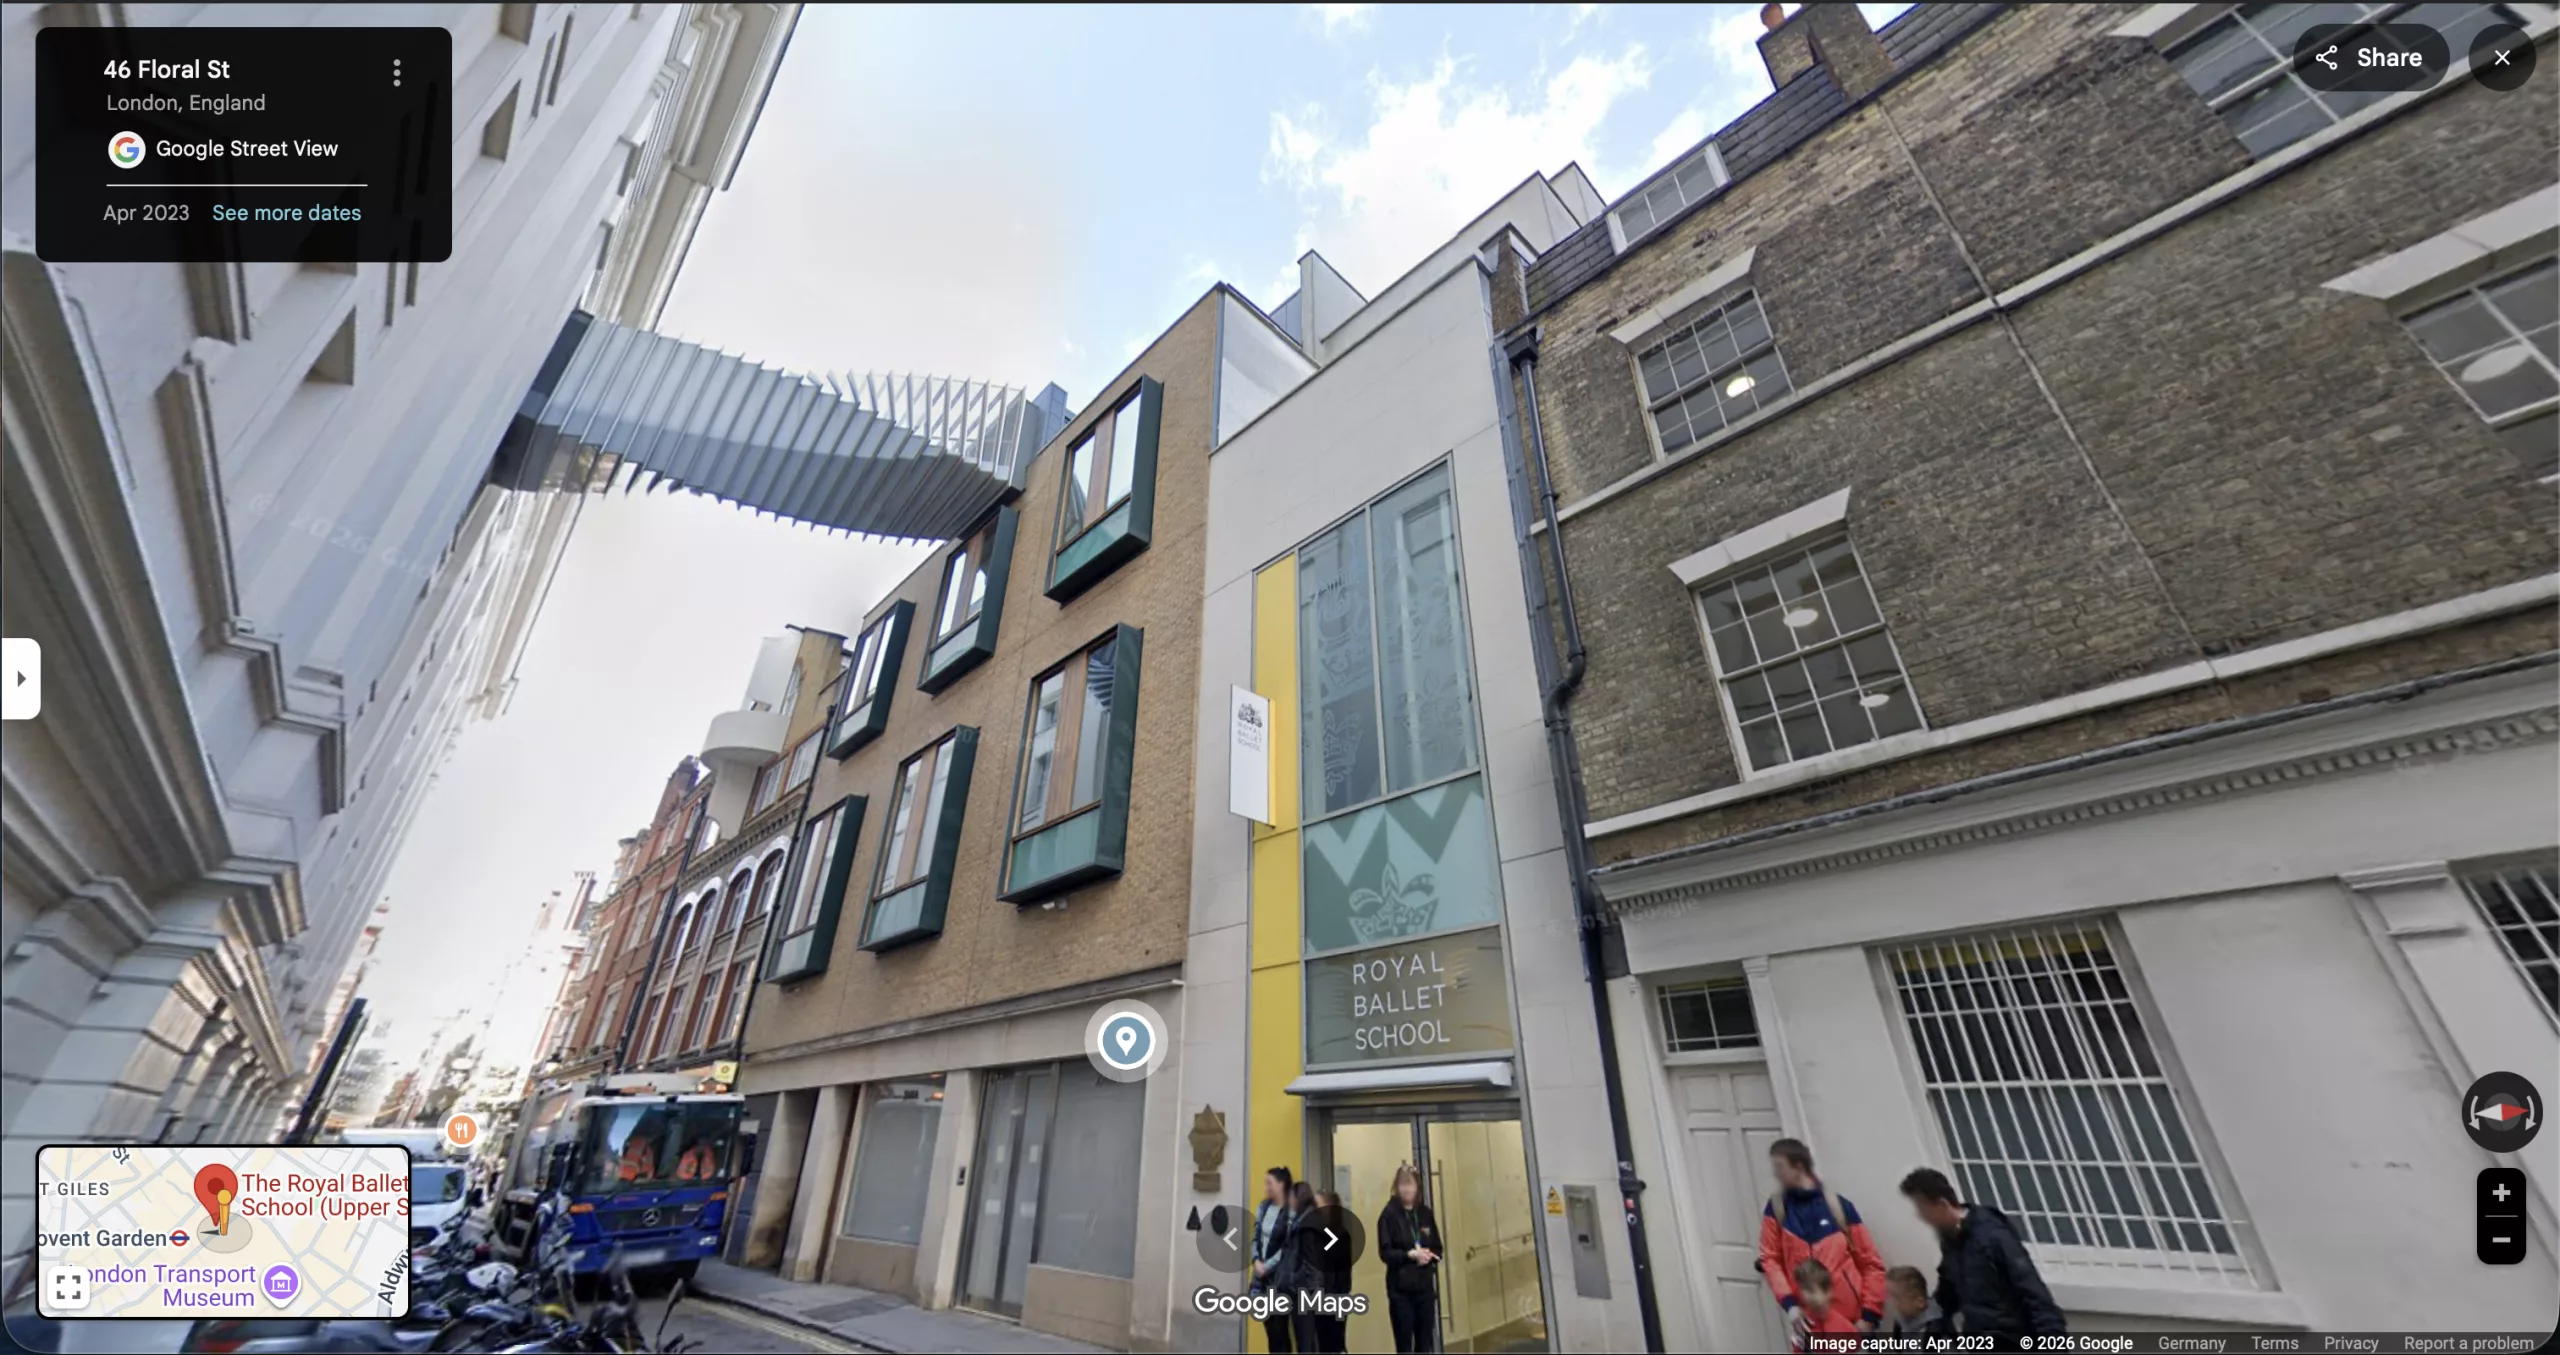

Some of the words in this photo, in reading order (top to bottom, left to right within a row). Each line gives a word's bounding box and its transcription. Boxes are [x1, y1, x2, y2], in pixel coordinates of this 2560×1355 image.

[1353, 951, 1445, 985] ROYAL
[1354, 984, 1446, 1017] BALLET
[1355, 1020, 1451, 1050] SCHOOL
